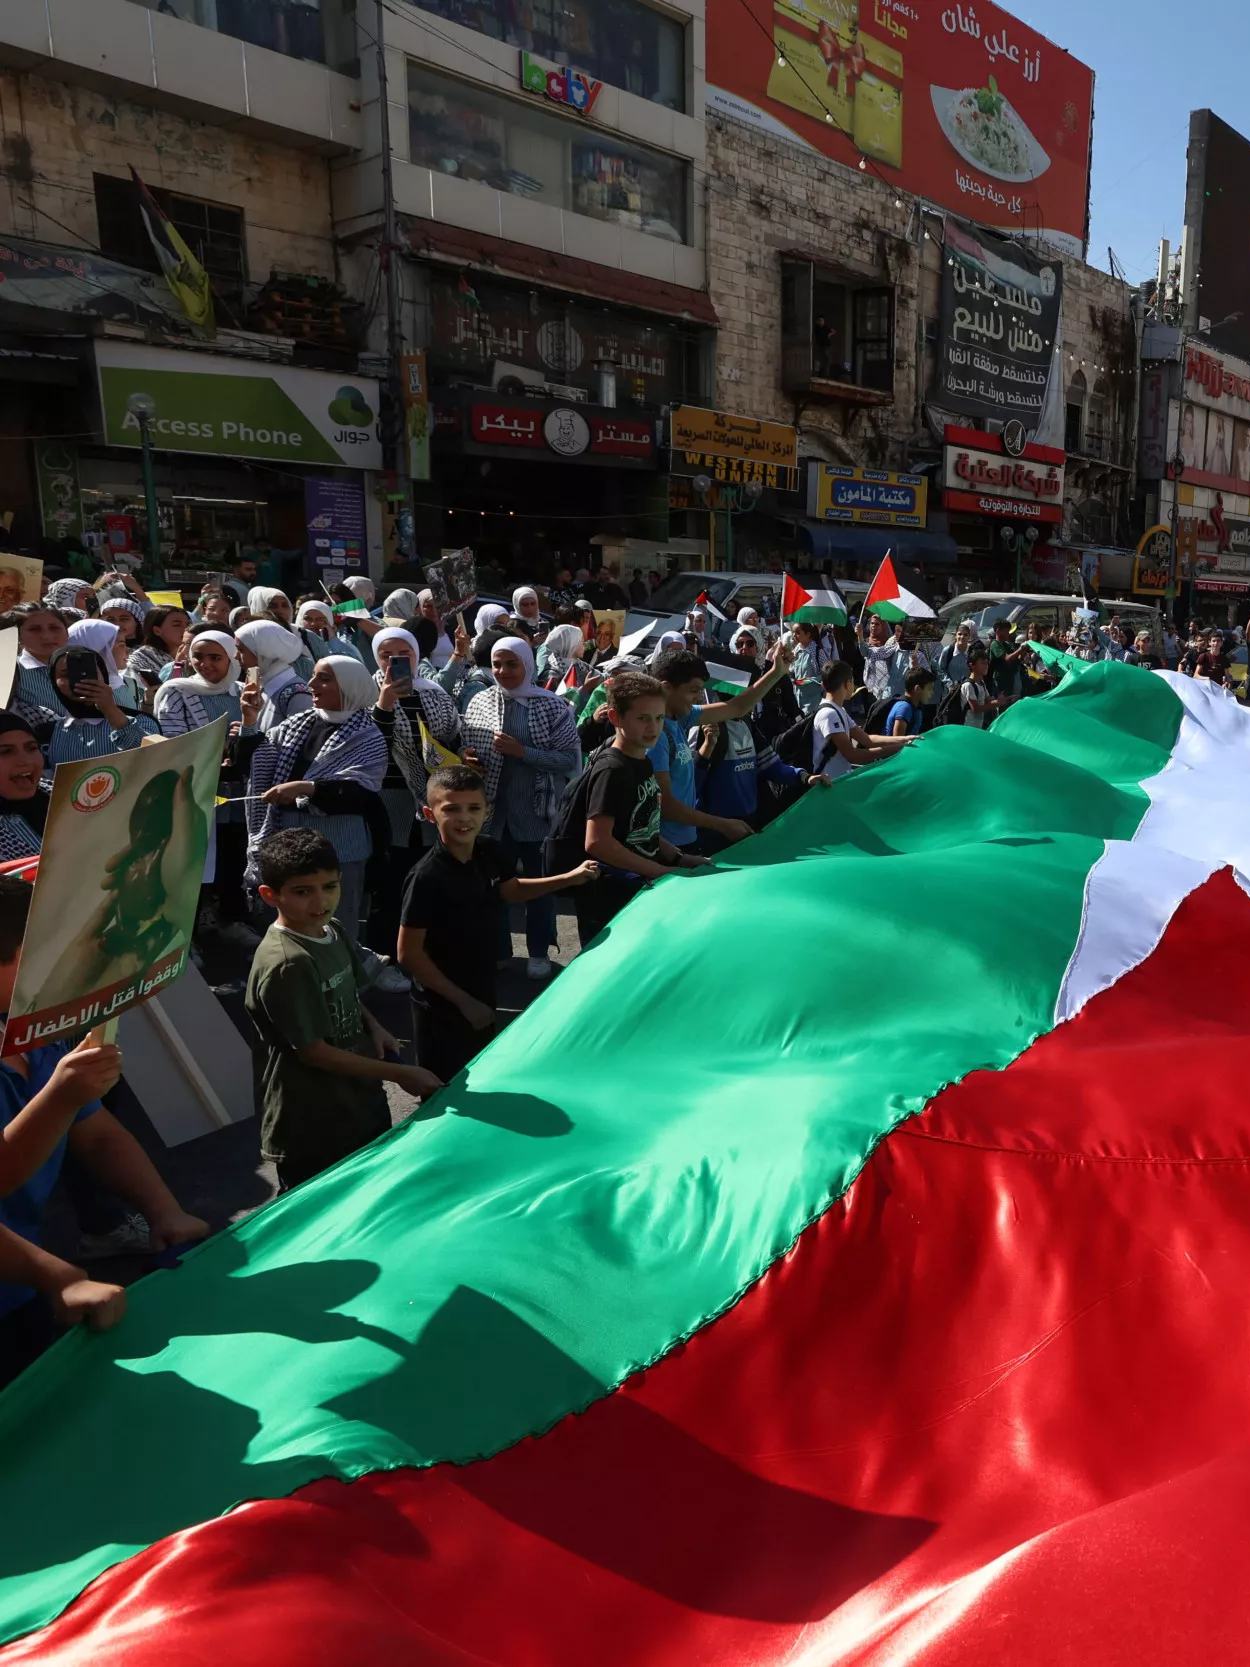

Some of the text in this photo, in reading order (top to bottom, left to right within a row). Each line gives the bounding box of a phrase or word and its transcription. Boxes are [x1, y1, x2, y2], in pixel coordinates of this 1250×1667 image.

[941, 4, 981, 39] شان
[519, 50, 602, 113] baby
[987, 184, 1006, 206] حبة
[953, 307, 1004, 343] للبيع
[121, 411, 303, 447] Access Phone
[334, 429, 370, 444] جوال
[480, 413, 650, 444] مستر بيكر
[685, 451, 777, 477] WESTERN
[715, 467, 777, 487] UNION
[956, 452, 1061, 497] شركة العتبة
[879, 486, 911, 508] مكتبة
[734, 761, 755, 773] adidas
[103, 986, 136, 1016] قتل
[14, 1002, 100, 1046] الاطفال
